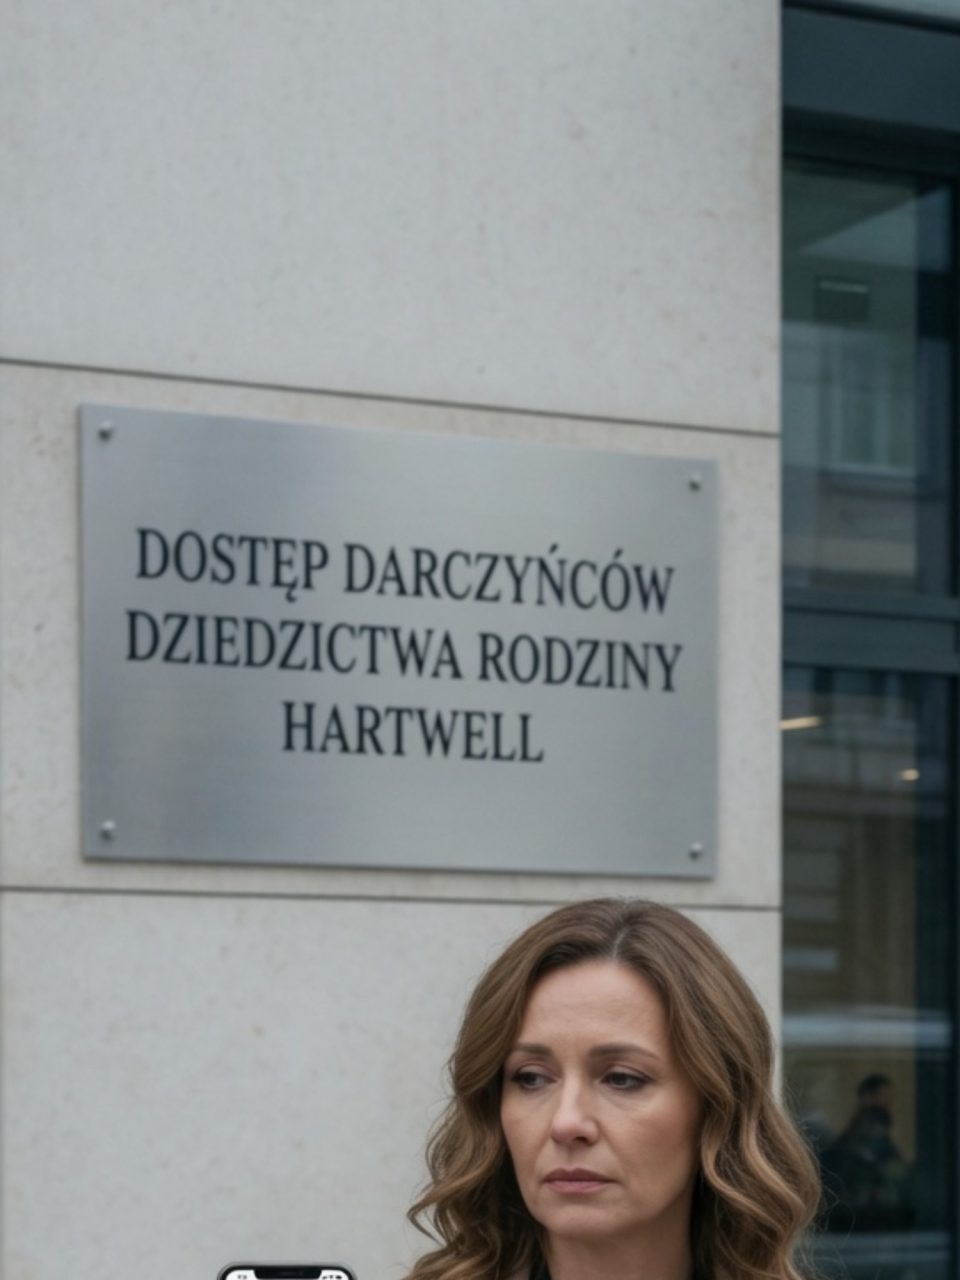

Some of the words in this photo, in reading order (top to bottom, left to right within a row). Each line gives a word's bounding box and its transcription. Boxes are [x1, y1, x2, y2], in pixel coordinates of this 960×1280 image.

[136, 528, 329, 602] DOSTĘP
[343, 543, 675, 614] DARCZYŃCÓW
[126, 610, 464, 680] DZIEDZICTWA
[477, 632, 683, 692] RODZINY
[282, 701, 545, 763] HARTWELL
